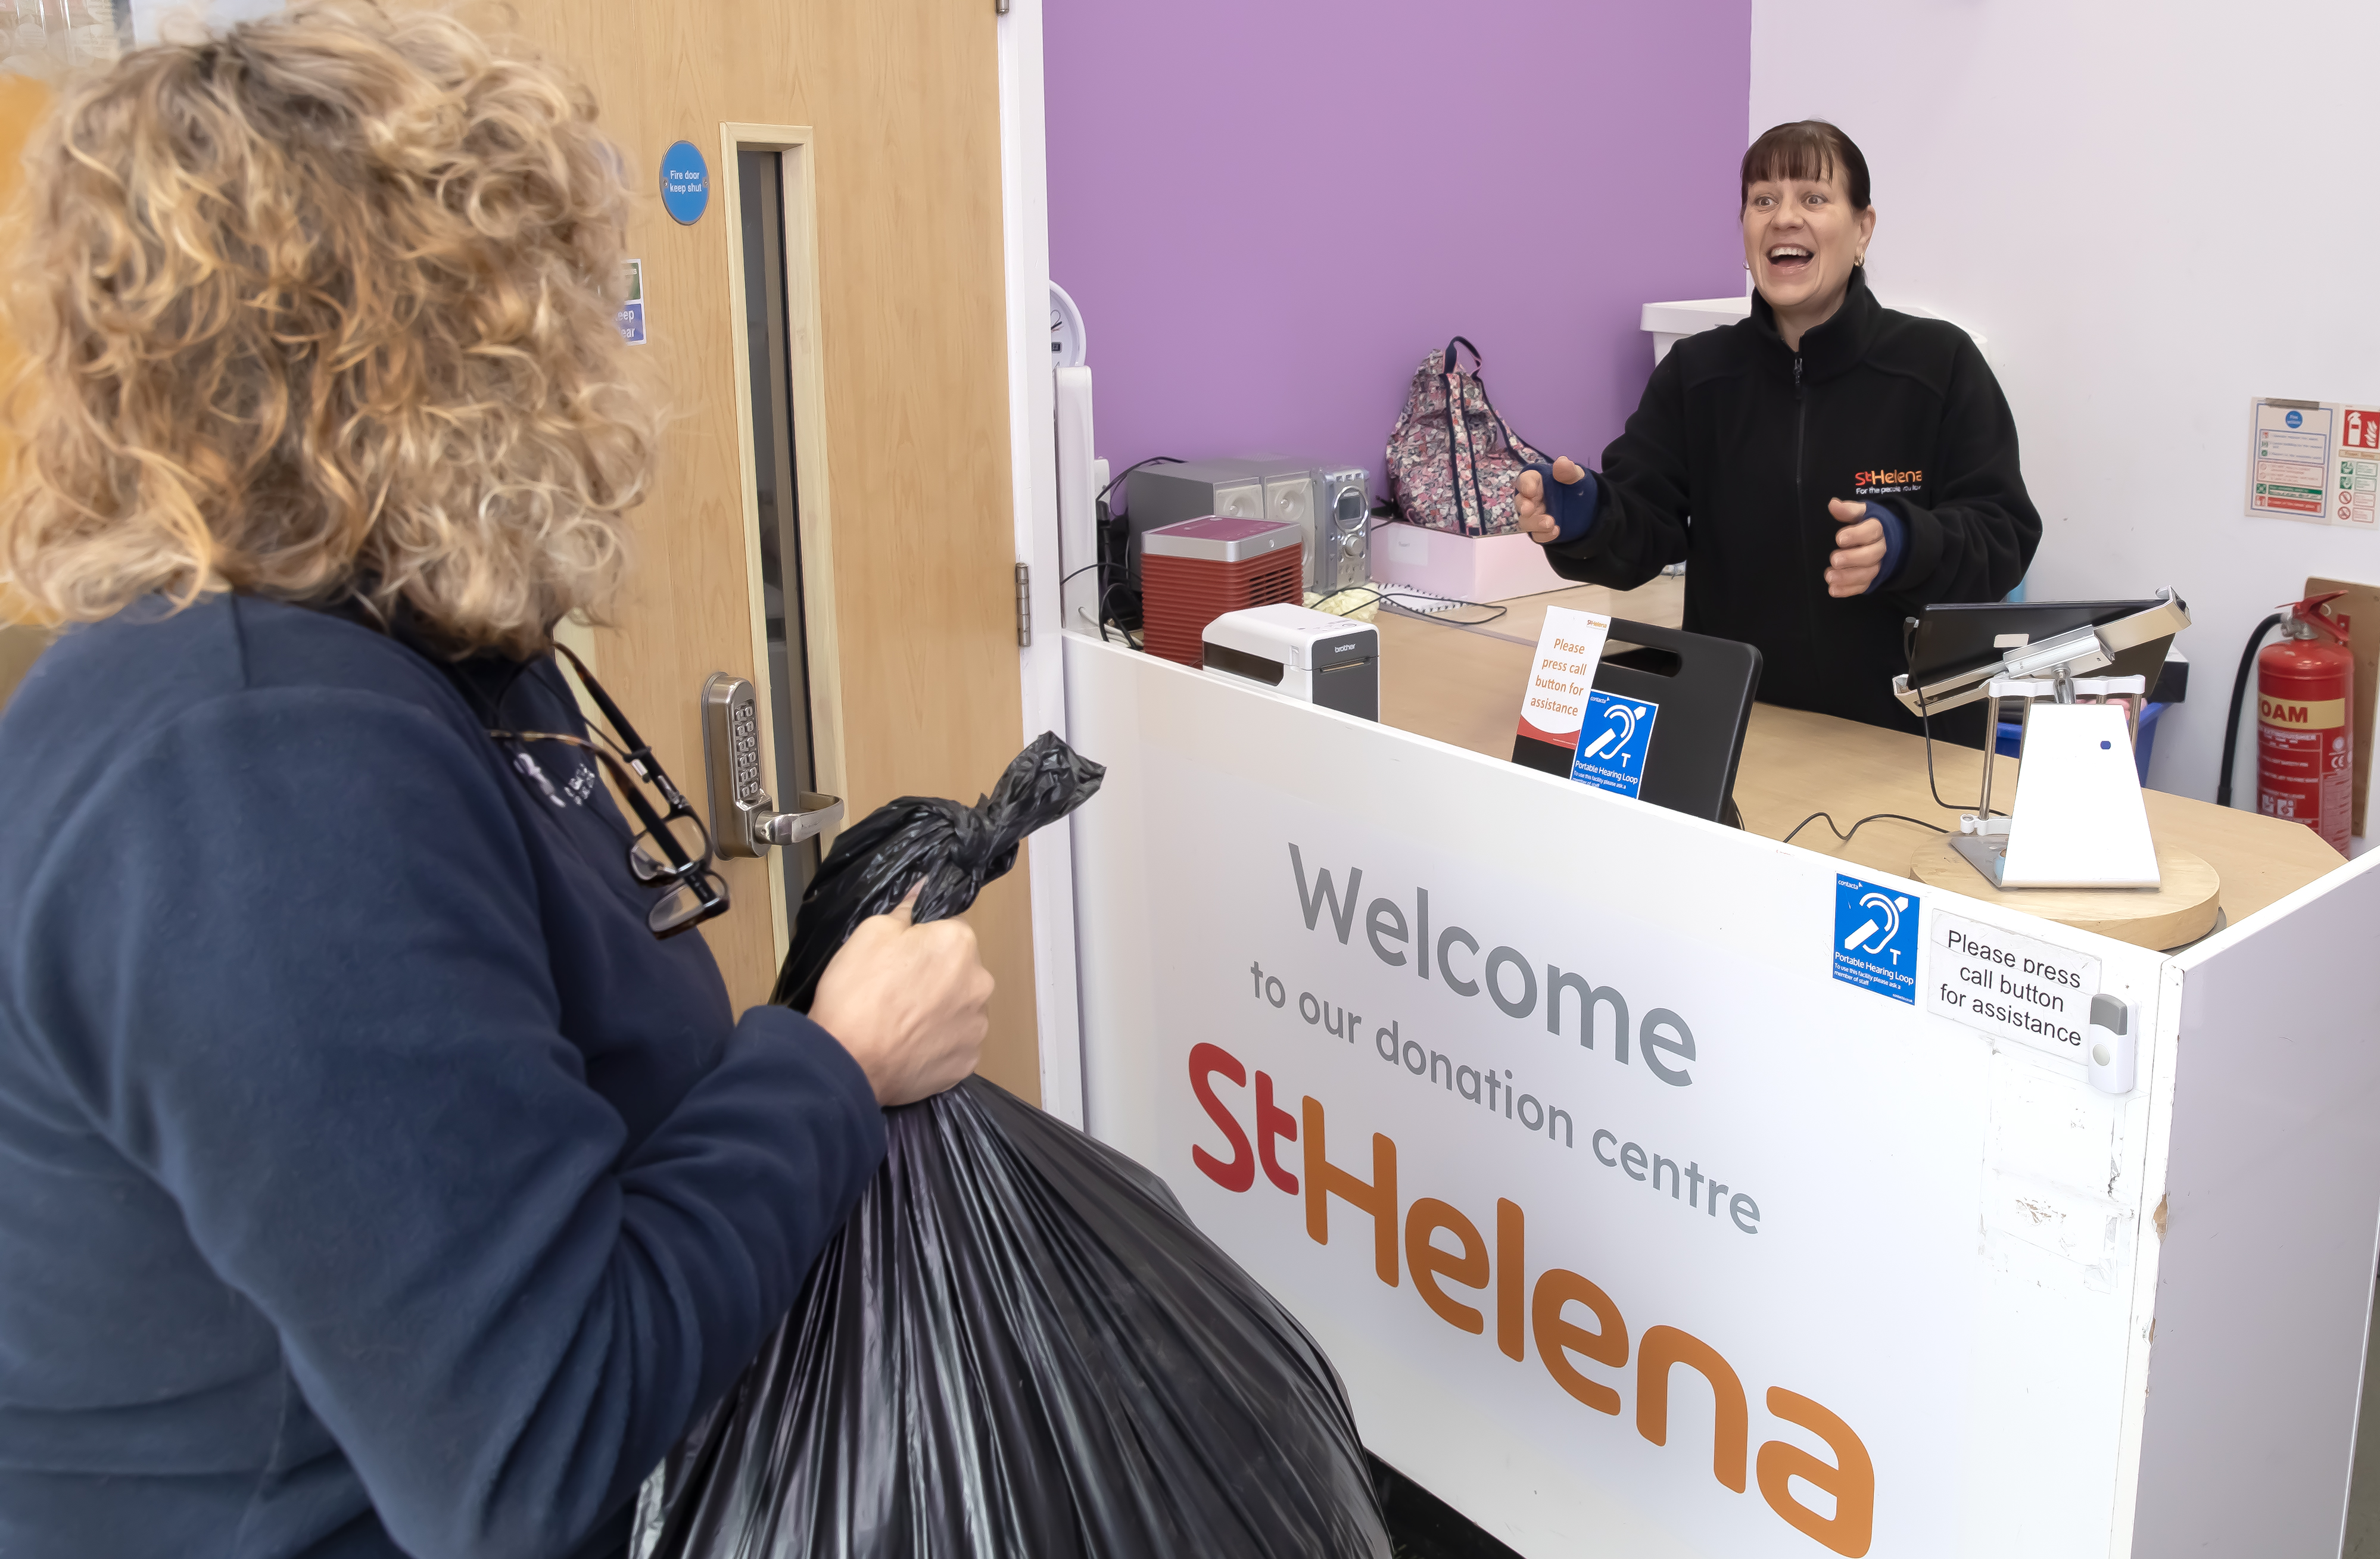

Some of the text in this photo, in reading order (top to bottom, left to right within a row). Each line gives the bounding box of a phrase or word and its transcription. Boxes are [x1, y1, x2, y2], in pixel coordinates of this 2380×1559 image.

[670, 170, 700, 179] Fire door
[670, 183, 702, 195] keep shut
[617, 310, 634, 323] eep
[1855, 469, 1922, 485] StHelena
[1881, 486, 1901, 494] people
[1335, 644, 1356, 653] brother
[1554, 638, 1585, 654] Please
[1541, 659, 1587, 675] press call
[1535, 675, 1584, 696] button for
[1531, 697, 1578, 716] assistance
[2261, 700, 2308, 723] OAM
[1575, 760, 1638, 785] Portable Hearing Loop
[1591, 775, 1603, 784] facility
[1838, 880, 1858, 890] contacta
[1288, 843, 1696, 1087] Welcome
[1948, 930, 2080, 988] Please press
[1834, 971, 1853, 980] member
[1835, 952, 1914, 986] Portable Hearing Loop
[1858, 971, 1873, 981] facility
[1873, 976, 1888, 986] please
[1960, 967, 2063, 1012] call button
[1940, 983, 2081, 1046] for assistance
[1251, 961, 1760, 1234] to our donation centre
[1189, 1043, 1875, 1558] StHelena
